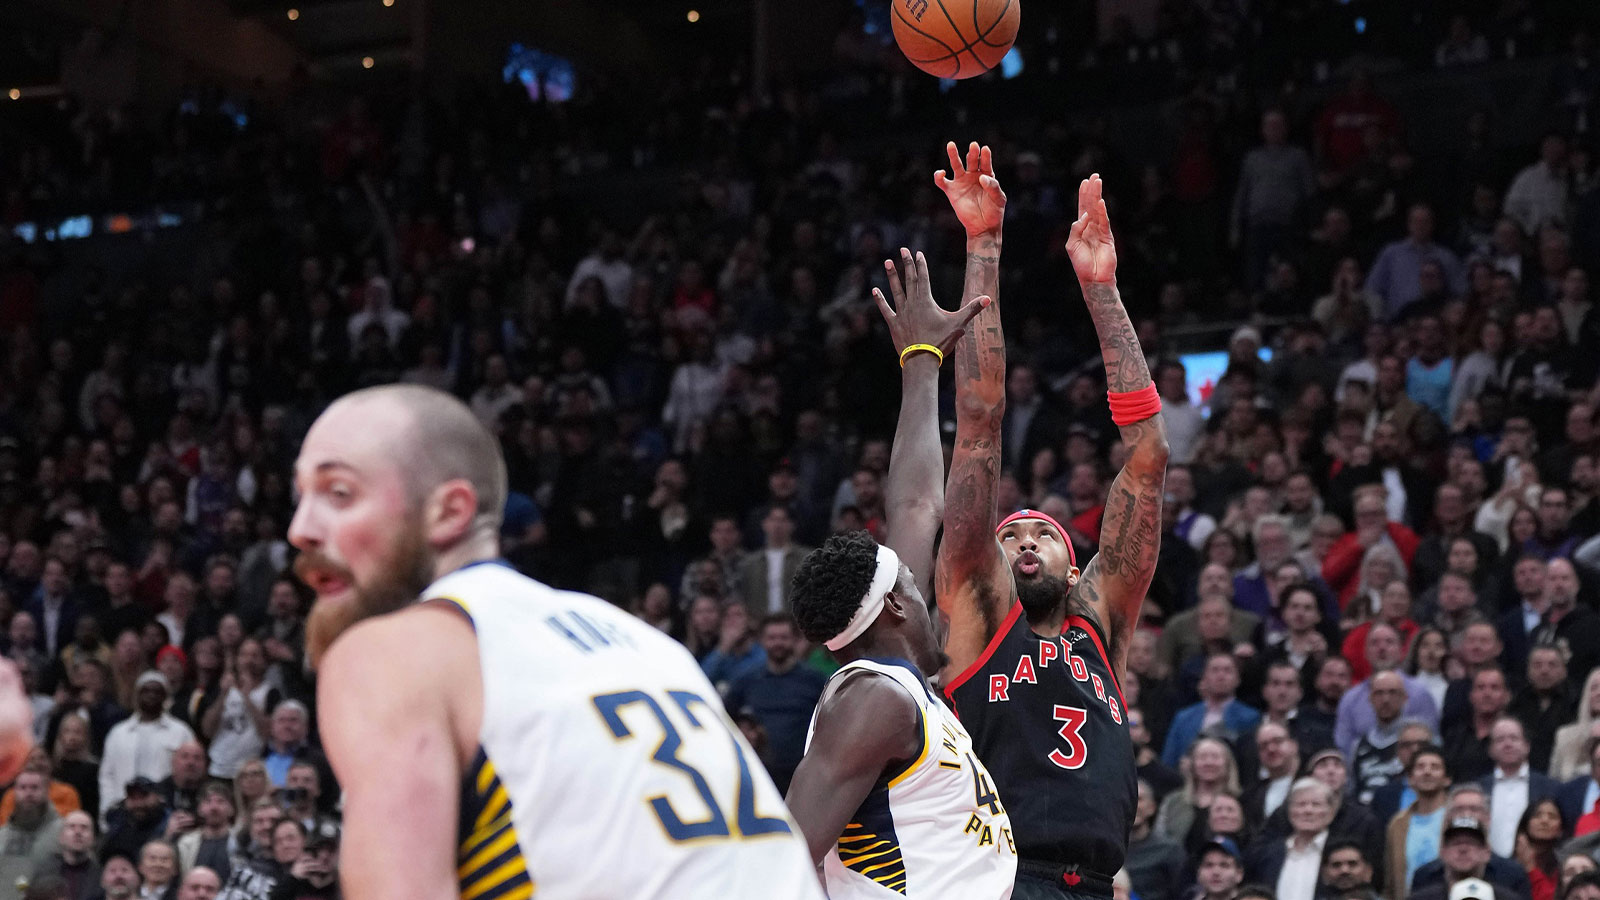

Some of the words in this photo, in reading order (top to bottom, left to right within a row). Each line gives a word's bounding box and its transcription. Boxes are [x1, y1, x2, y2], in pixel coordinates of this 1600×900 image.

[989, 636, 1122, 724] RAPTORS
[590, 690, 793, 845] 32
[1048, 704, 1088, 770] 3
[965, 751, 1005, 816] 4
